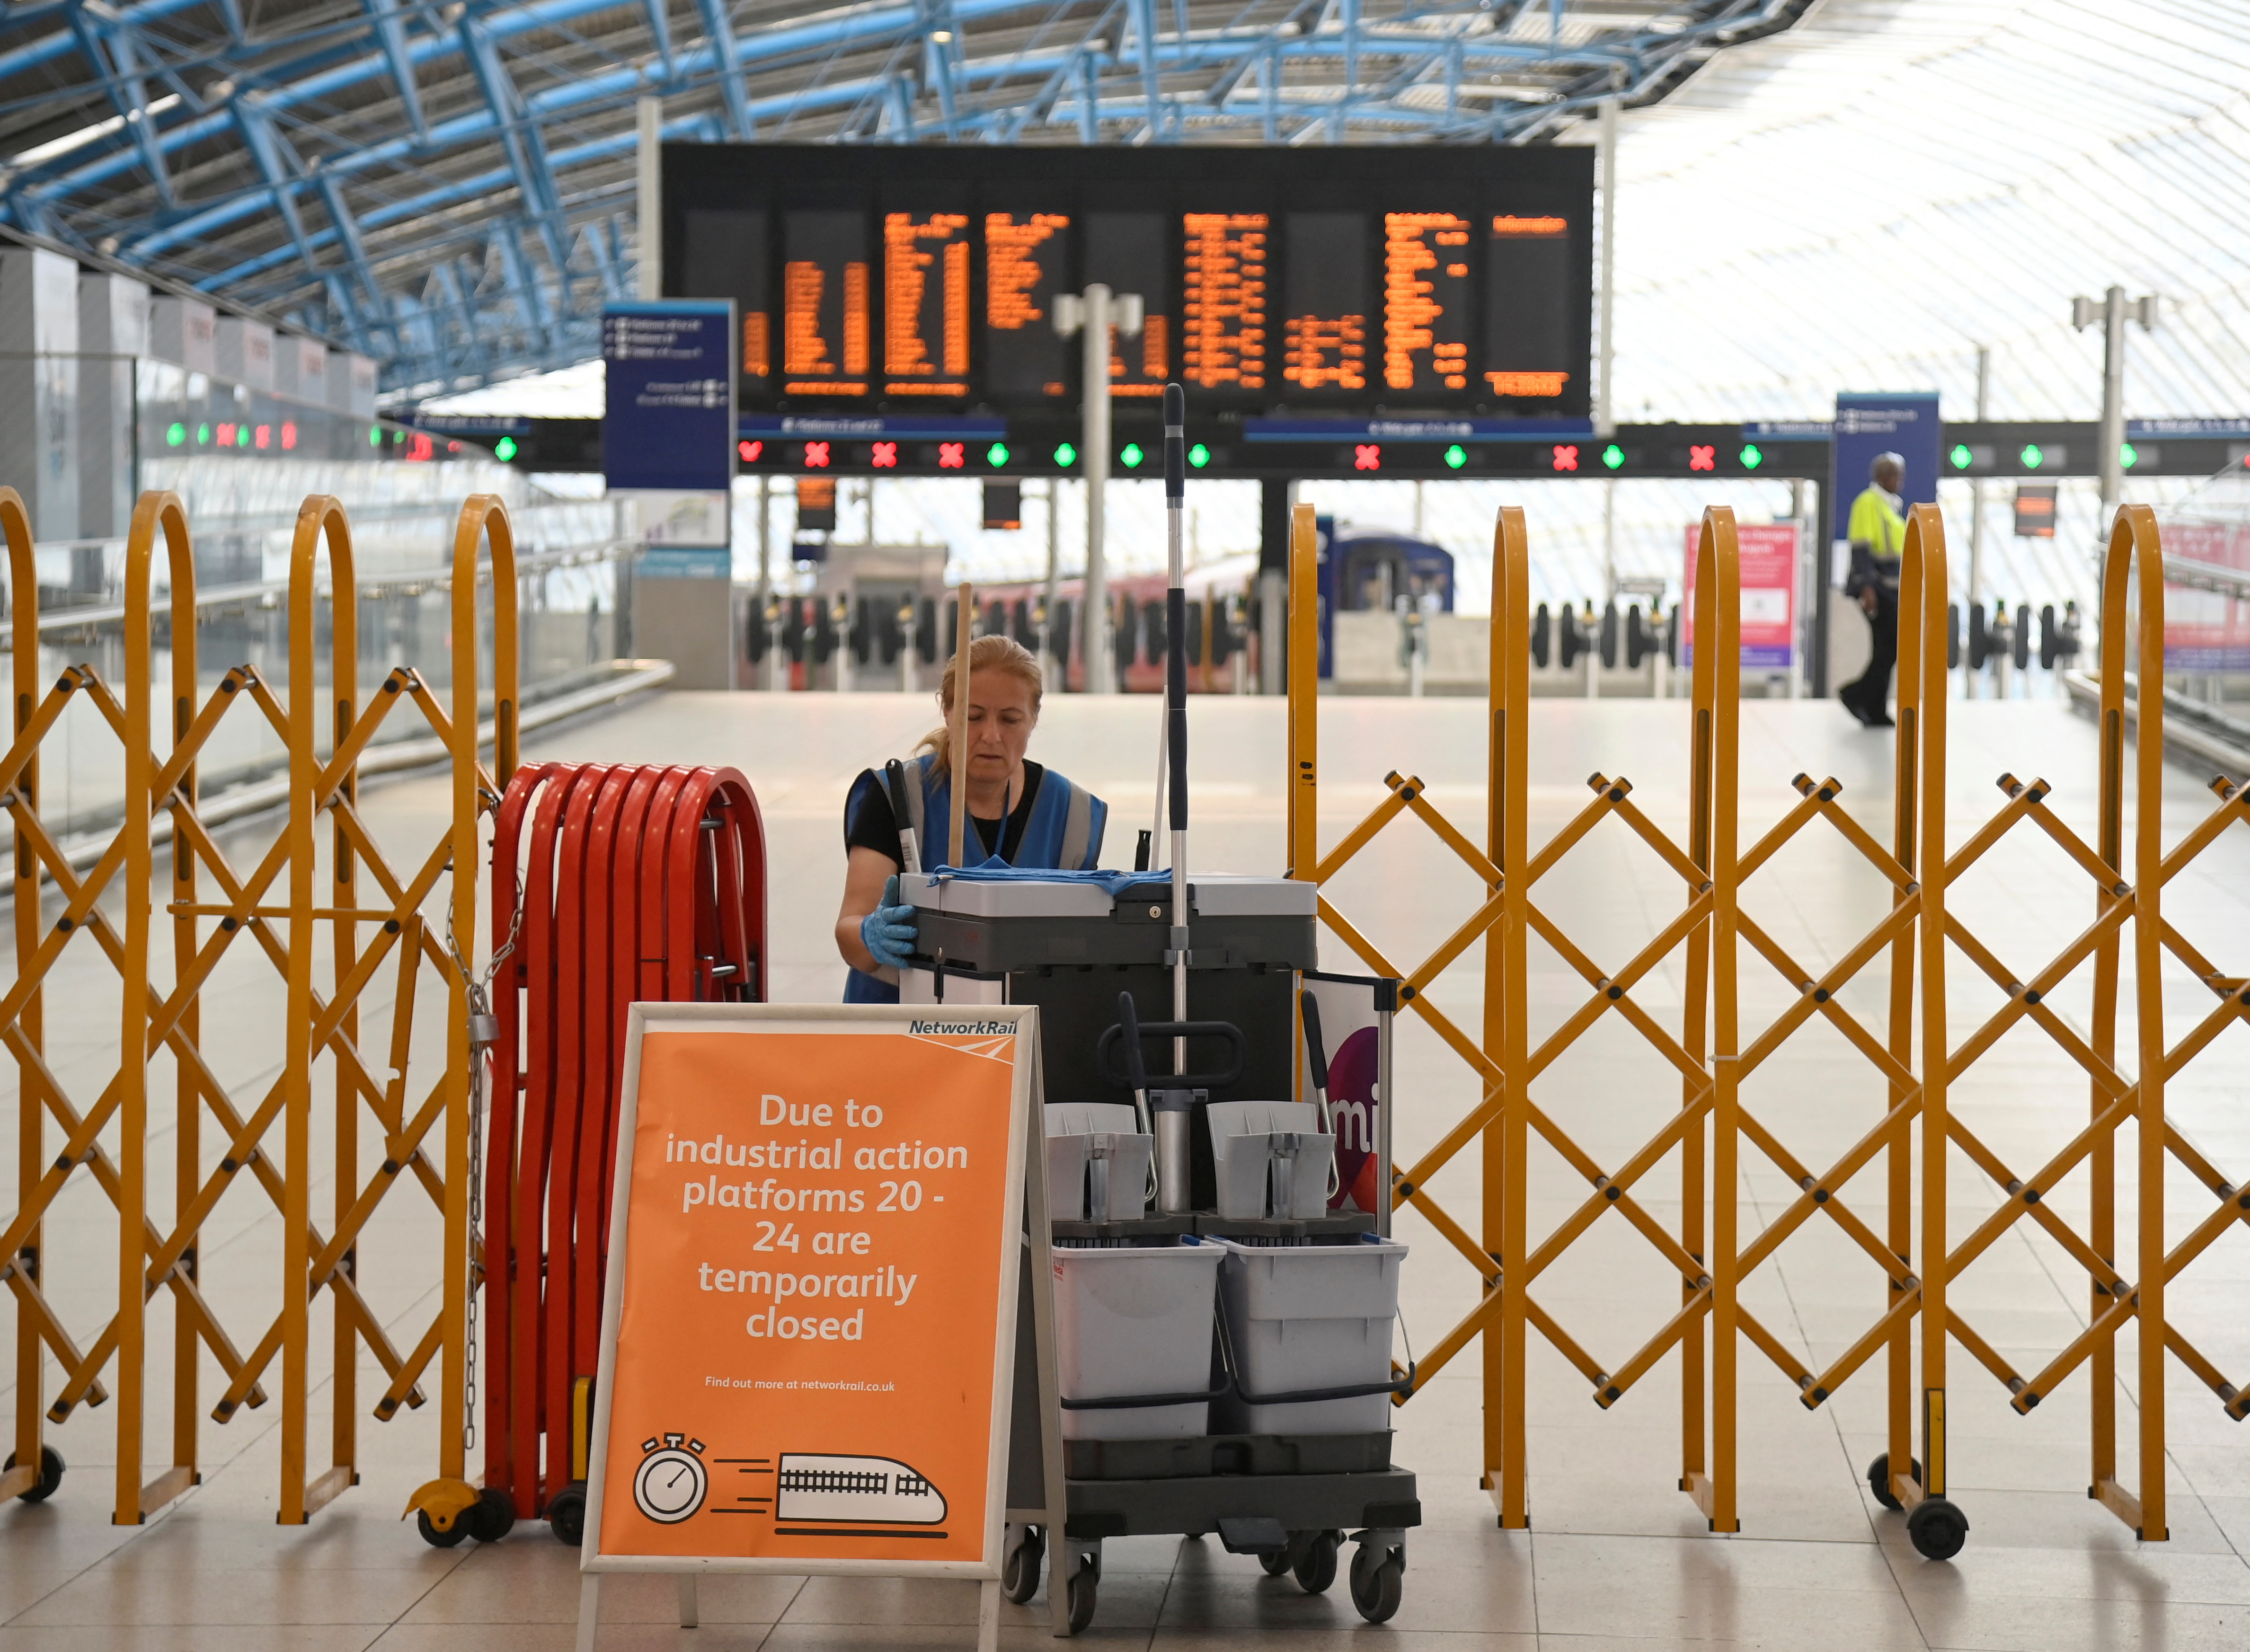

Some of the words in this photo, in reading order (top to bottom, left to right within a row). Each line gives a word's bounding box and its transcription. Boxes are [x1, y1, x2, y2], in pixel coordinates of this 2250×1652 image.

[909, 1020, 1017, 1034] NetworkRail
[760, 1094, 833, 1127] Due
[844, 1099, 883, 1128] to
[665, 1133, 842, 1170] industrial
[854, 1140, 968, 1170] action
[683, 1175, 865, 1213] platforms
[877, 1180, 922, 1212] 20
[753, 1221, 800, 1253] 24
[812, 1232, 871, 1254] are
[698, 1262, 918, 1306] temporarily
[746, 1306, 864, 1341] closed
[705, 1376, 730, 1387] Find
[733, 1379, 752, 1388] out
[755, 1380, 784, 1389] more
[786, 1380, 798, 1389] at
[801, 1380, 895, 1392] networkrail.co.uk
